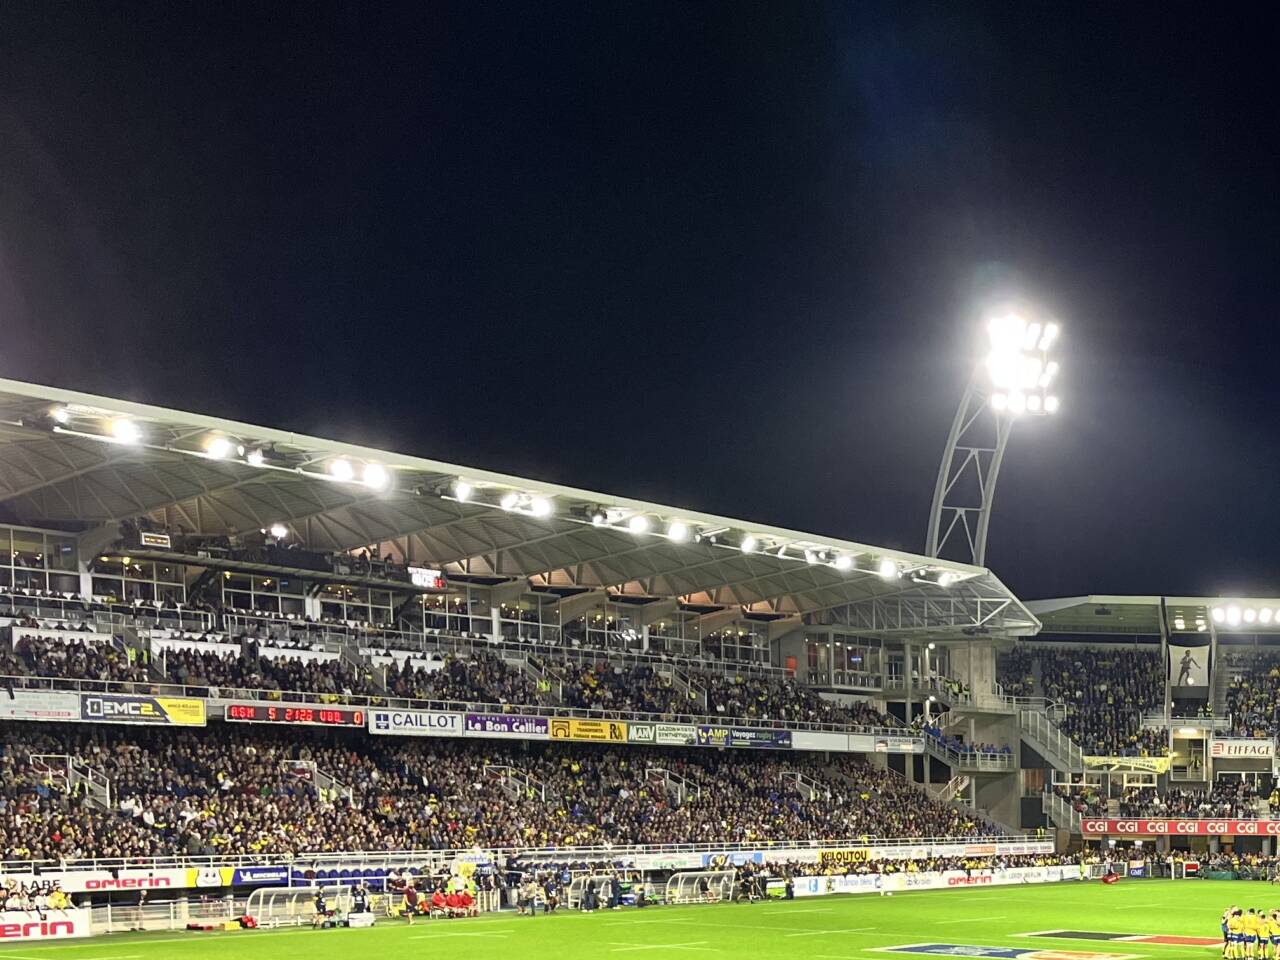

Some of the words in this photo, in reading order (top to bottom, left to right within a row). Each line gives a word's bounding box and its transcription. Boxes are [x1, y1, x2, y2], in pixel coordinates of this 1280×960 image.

[392, 713, 457, 727] CAILLOT
[468, 720, 482, 731] Le
[485, 720, 508, 732] Bon
[512, 722, 546, 733] Cellier
[1227, 743, 1271, 754] EIFFAGE
[1086, 822, 1108, 832] CGI
[1116, 822, 1138, 832] CGI
[1146, 822, 1168, 832] CGI
[1176, 822, 1198, 832] CGI
[1206, 823, 1228, 833] CGI
[1236, 823, 1258, 833] CGI
